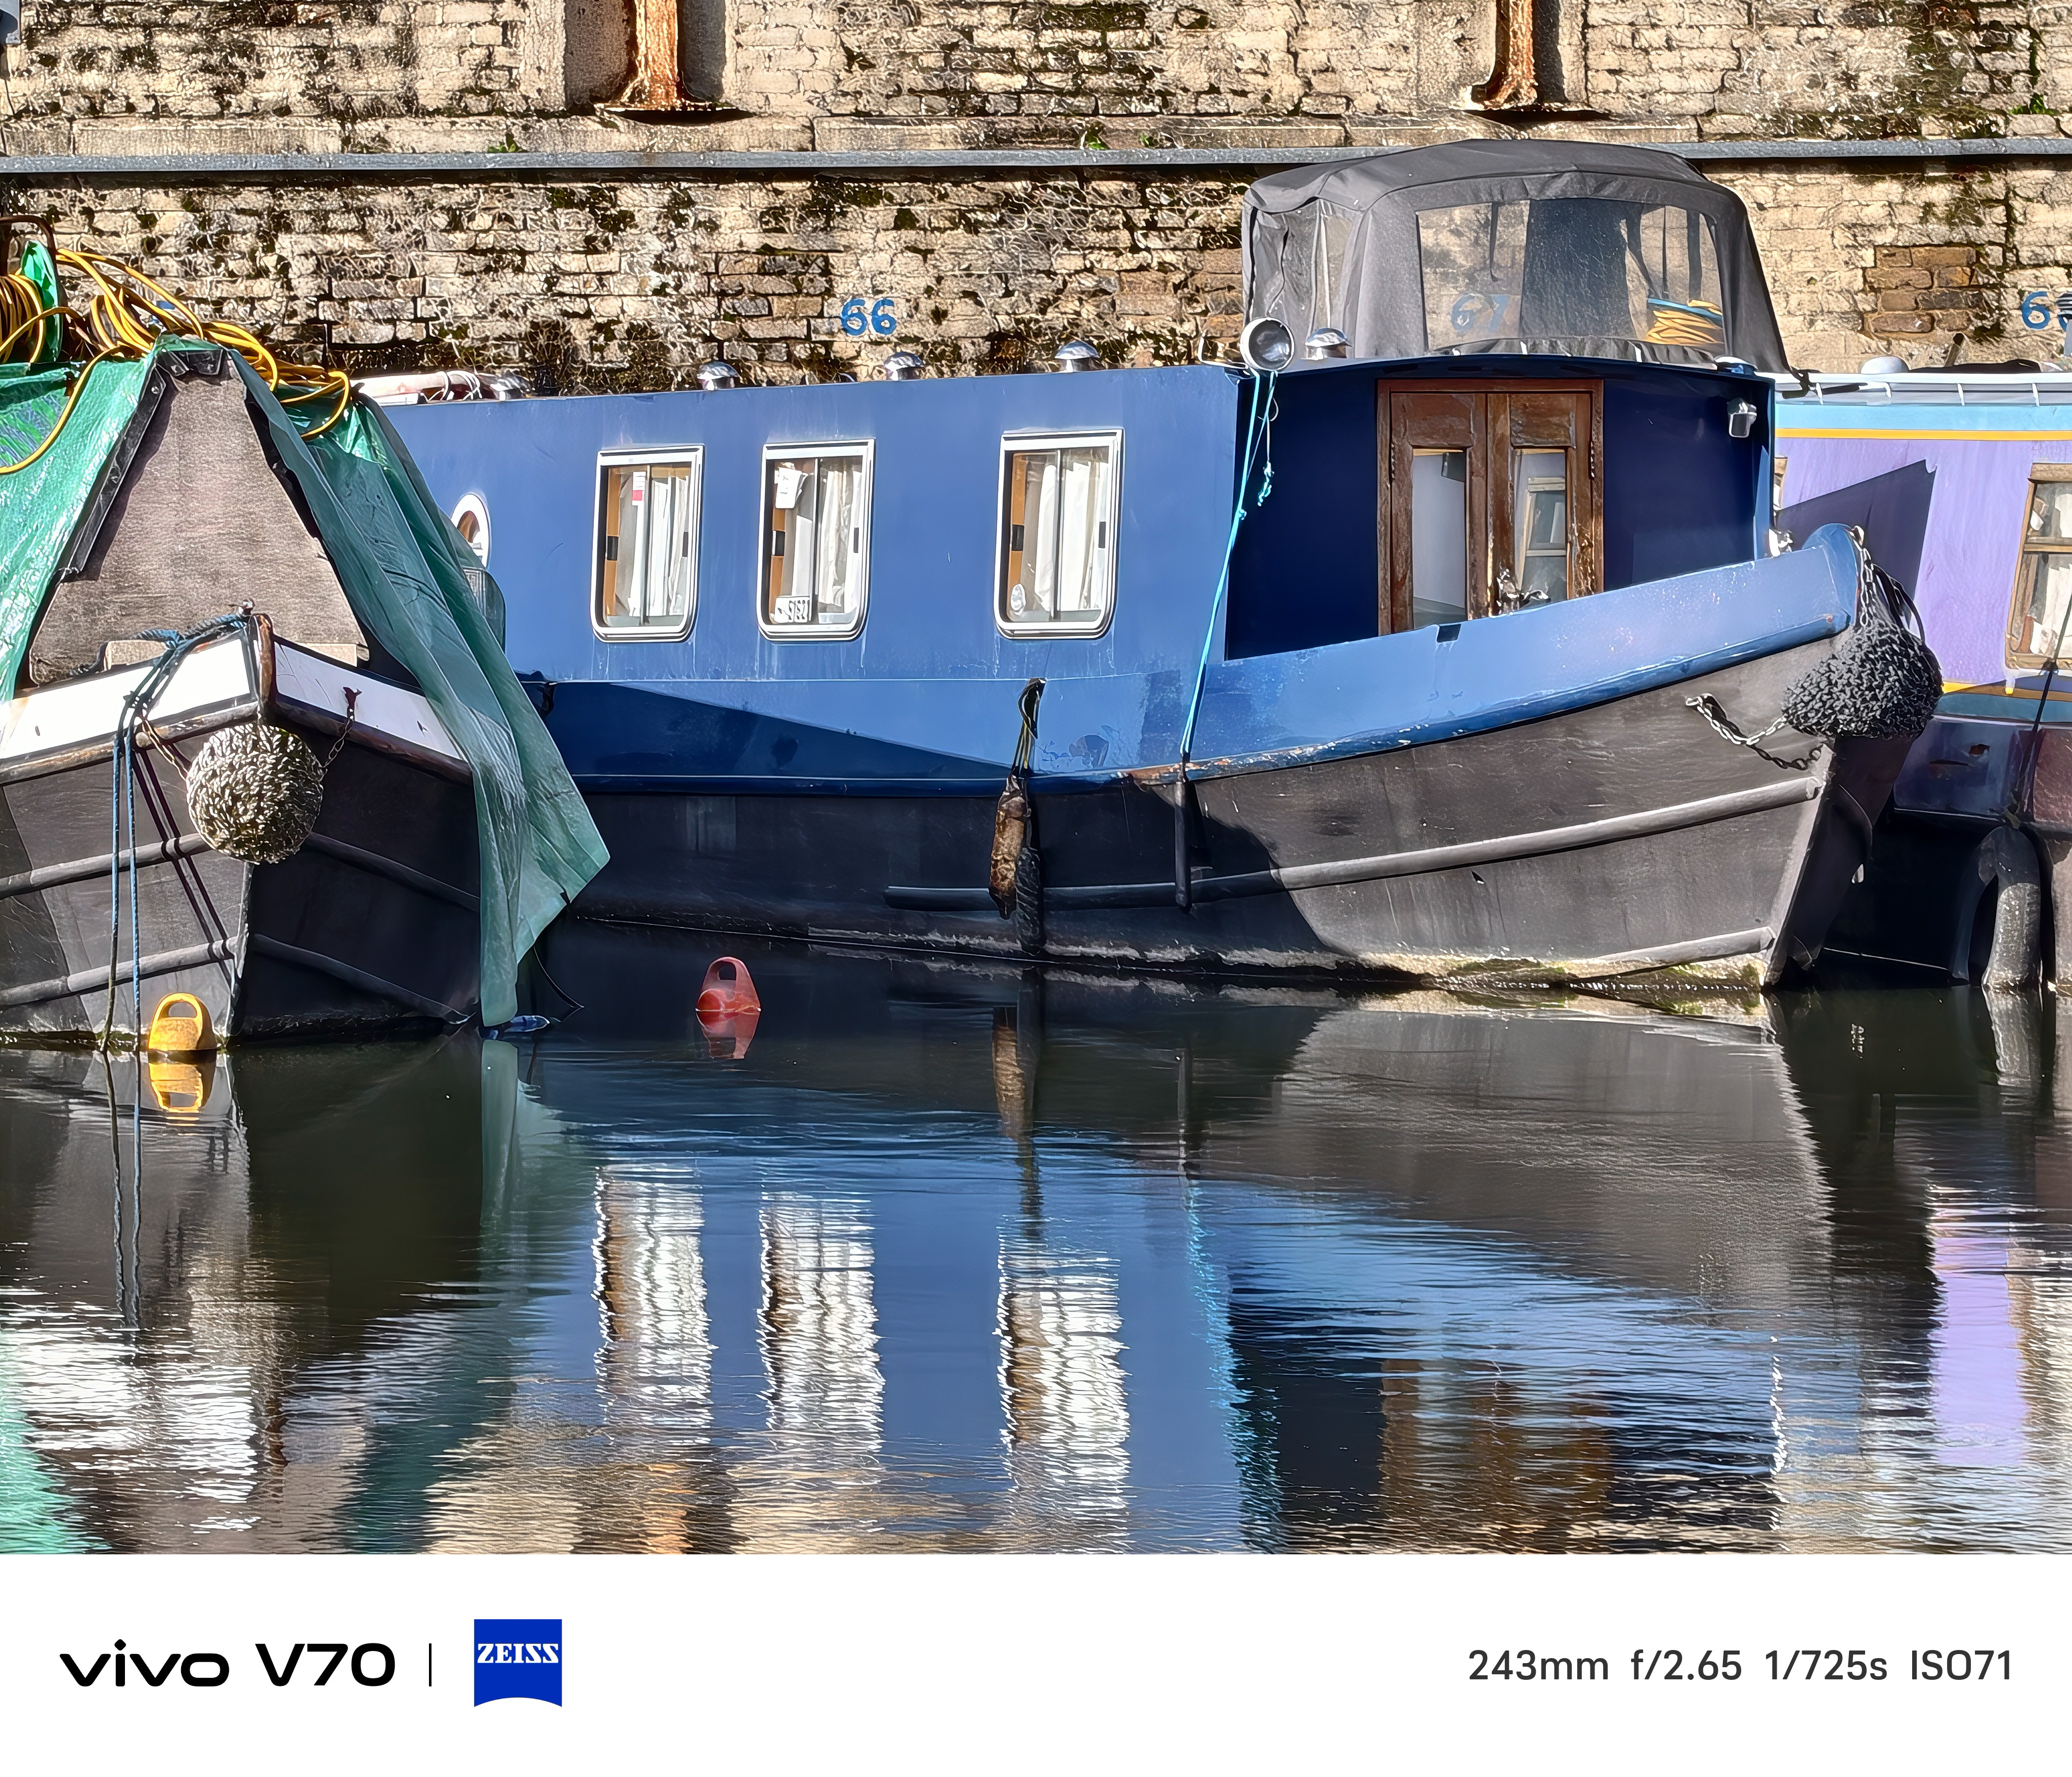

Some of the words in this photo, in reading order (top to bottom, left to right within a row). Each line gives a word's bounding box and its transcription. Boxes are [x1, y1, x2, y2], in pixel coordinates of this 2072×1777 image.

[840, 298, 897, 336] 66
[1450, 293, 1510, 334] 67
[2021, 291, 2068, 332] 6
